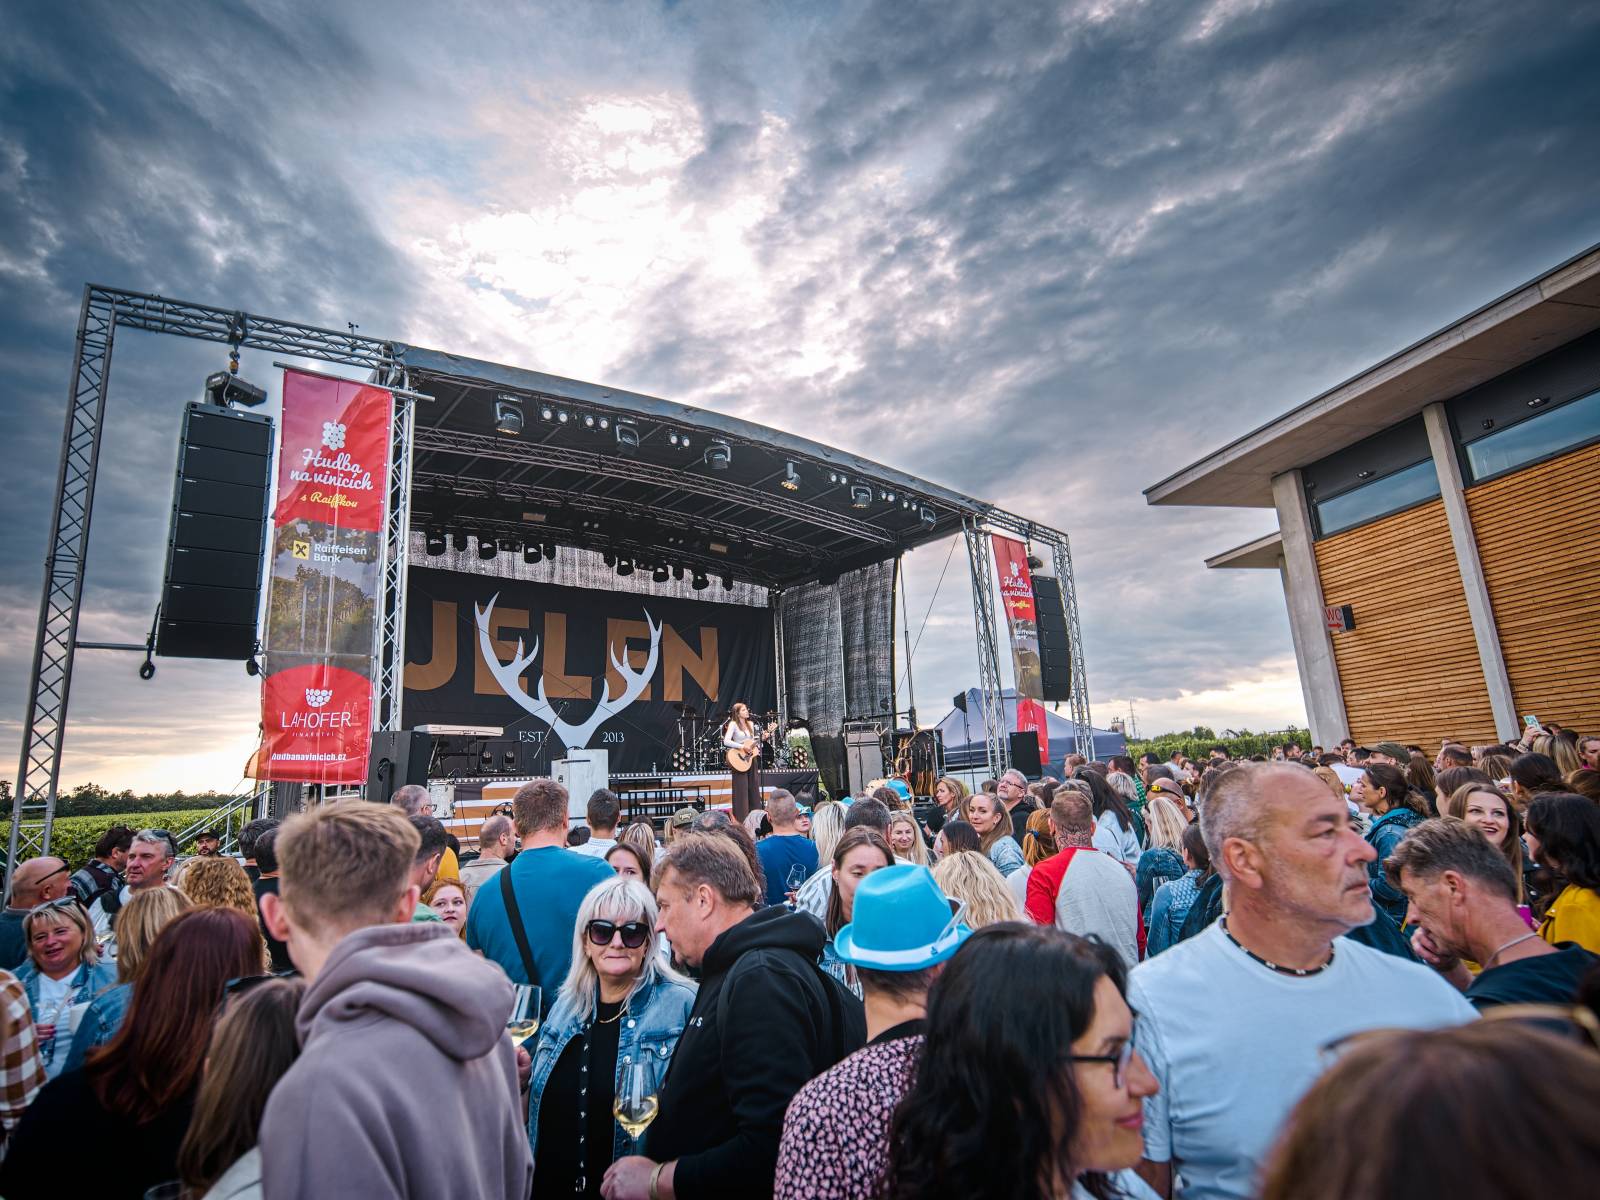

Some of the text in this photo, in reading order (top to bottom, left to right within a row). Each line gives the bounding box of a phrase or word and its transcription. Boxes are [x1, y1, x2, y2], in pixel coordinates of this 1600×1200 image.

[302, 449, 362, 474] Hudba
[290, 469, 373, 490] na vinicích
[301, 491, 358, 509] s Raiffkou
[313, 552, 341, 563] Bank
[314, 543, 367, 555] Raiffeisen
[1326, 607, 1343, 621] WC
[403, 598, 719, 702] JELEN
[281, 711, 351, 729] LAHOFER
[519, 731, 625, 743] EST 2013
